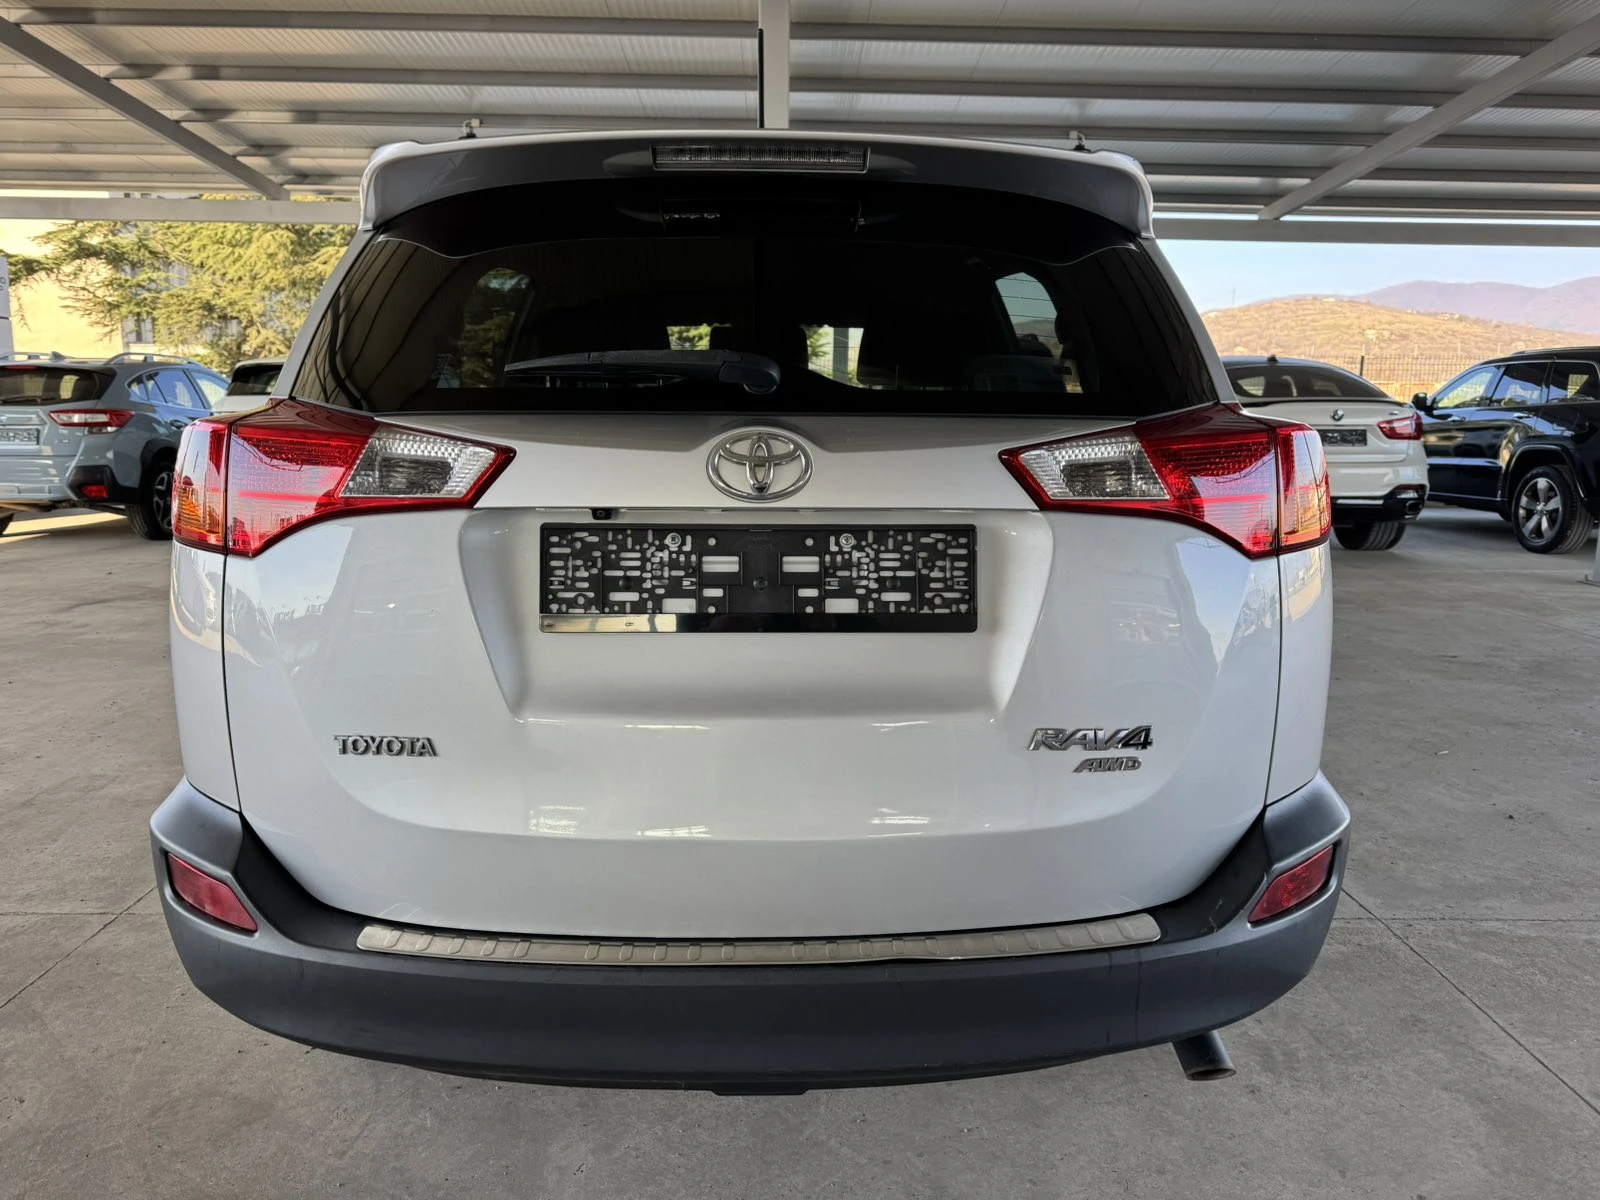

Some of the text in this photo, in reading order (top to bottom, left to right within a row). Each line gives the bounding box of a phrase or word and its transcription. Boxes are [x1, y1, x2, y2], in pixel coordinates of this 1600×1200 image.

[334, 735, 438, 757] TOYOTA
[1028, 725, 1153, 751] RAV4
[1073, 756, 1142, 773] AWD
